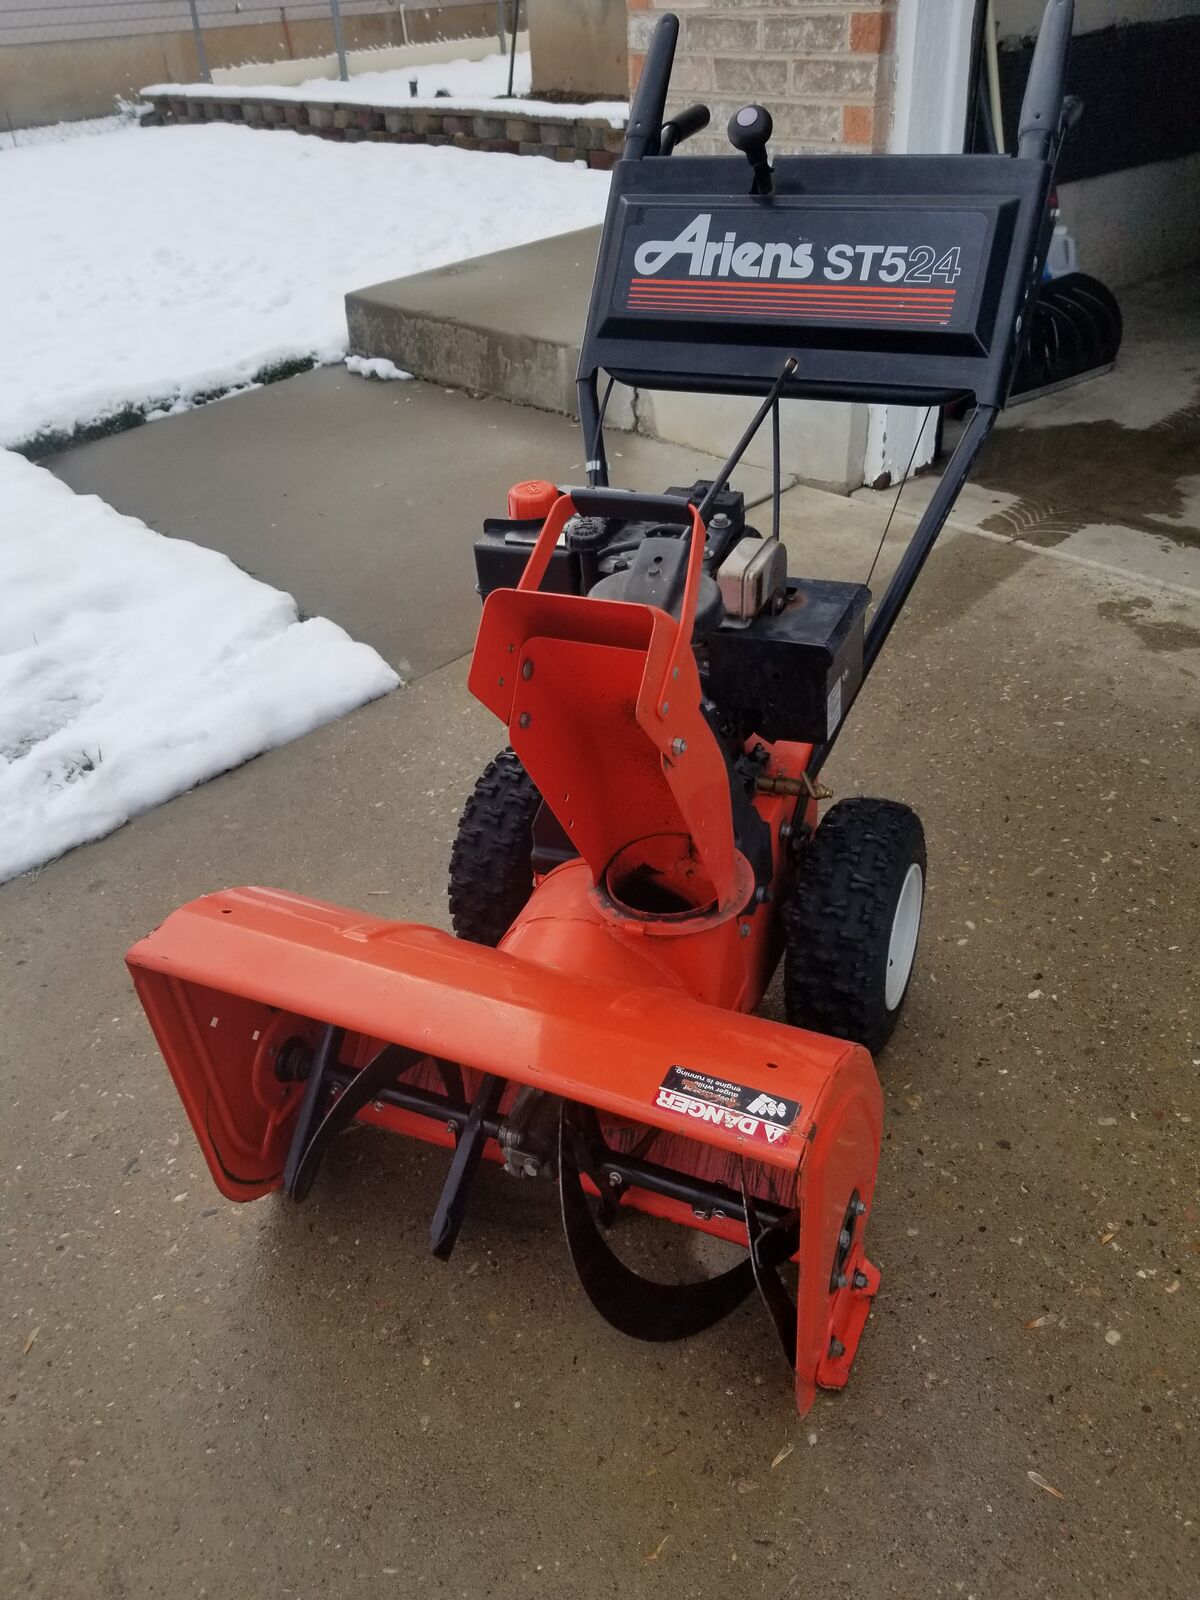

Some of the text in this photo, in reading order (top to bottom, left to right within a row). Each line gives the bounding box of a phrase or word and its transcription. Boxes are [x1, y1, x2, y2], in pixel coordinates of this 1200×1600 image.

[633, 213, 962, 284] Ariens ST524
[674, 1068, 706, 1081] running.
[714, 1080, 742, 1093] engine
[714, 1087, 739, 1098] auger
[655, 1090, 759, 1136] DANGER
